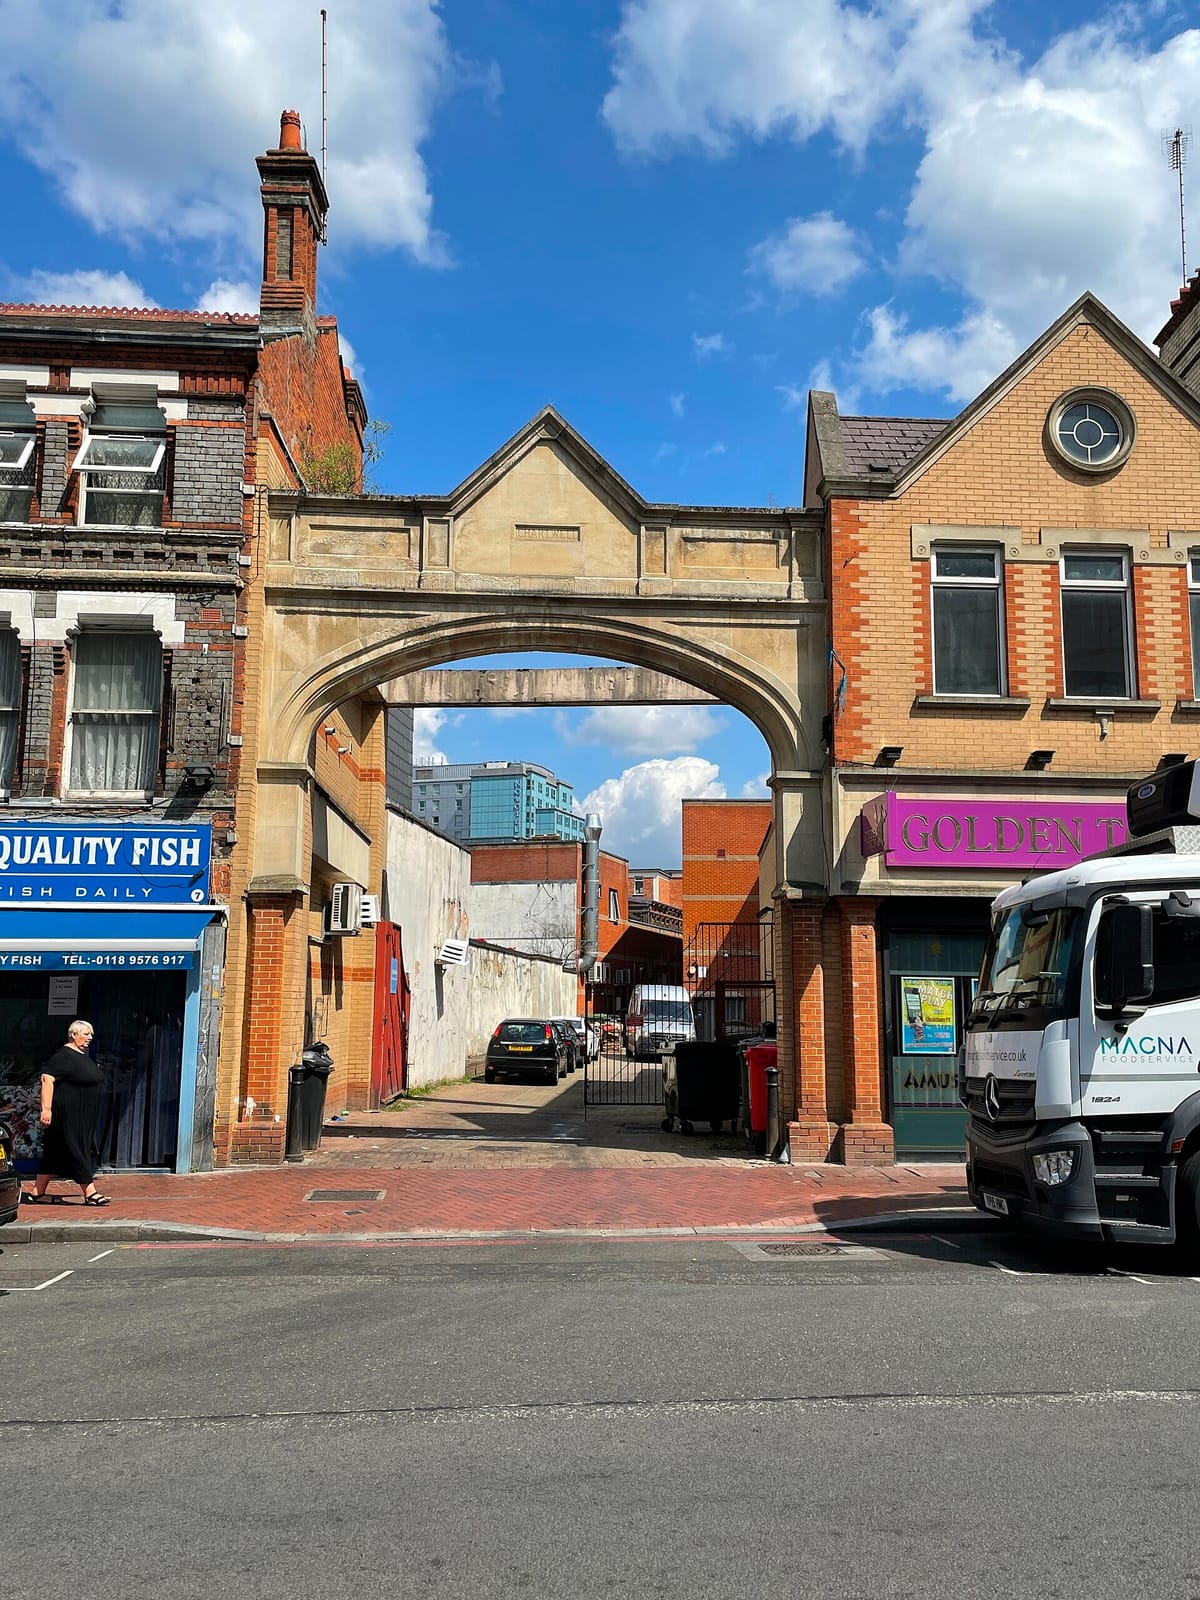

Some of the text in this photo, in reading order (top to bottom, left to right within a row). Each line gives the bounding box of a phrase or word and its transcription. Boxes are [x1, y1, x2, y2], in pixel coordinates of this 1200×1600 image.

[513, 779, 521, 833] NOVOTEL
[901, 815, 1083, 854] GOLDEN
[1096, 817, 1131, 850] T
[0, 835, 202, 870] QUALITY FISH
[0, 887, 153, 898] ISH DAILY
[194, 891, 202, 900] 7
[11, 955, 42, 966] FISH
[129, 955, 159, 966] 9576
[162, 955, 185, 965] 917
[921, 994, 946, 1007] PLAY
[1100, 1036, 1193, 1055] MAGNA
[1102, 1055, 1194, 1063] FOODSERVICE
